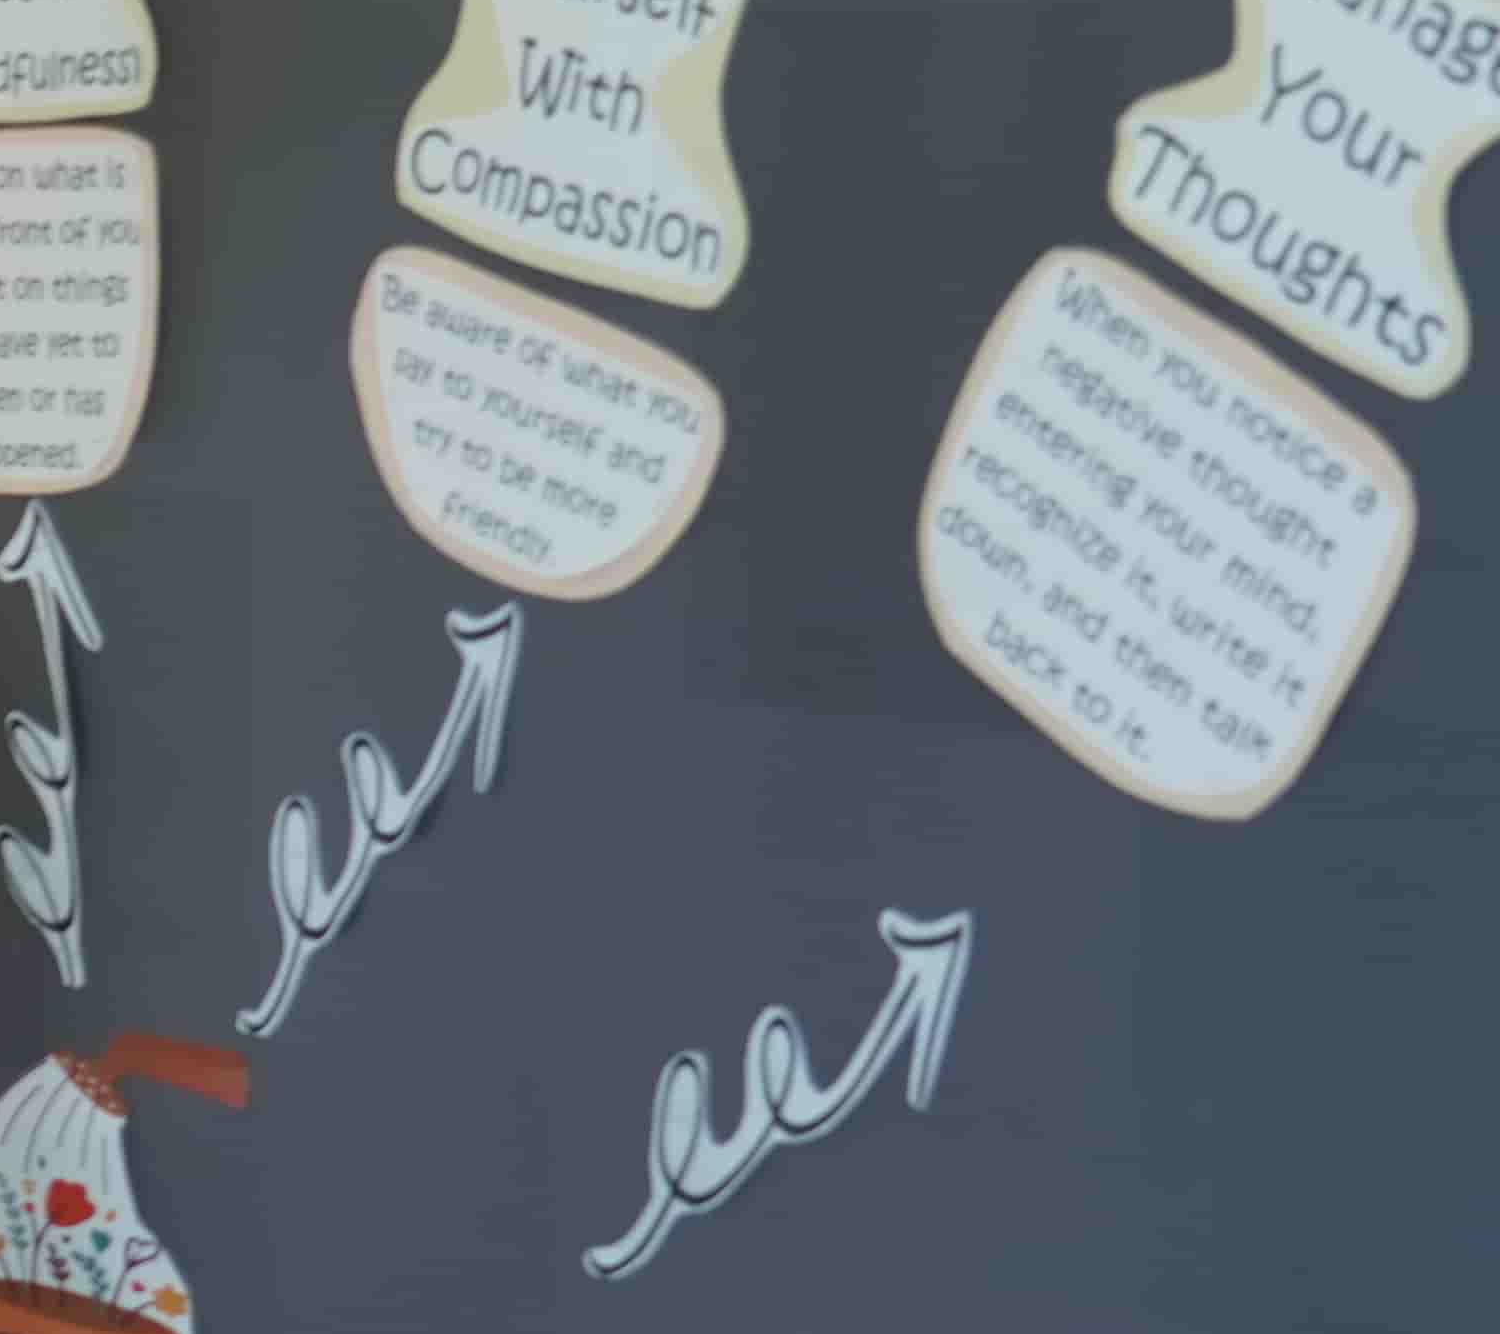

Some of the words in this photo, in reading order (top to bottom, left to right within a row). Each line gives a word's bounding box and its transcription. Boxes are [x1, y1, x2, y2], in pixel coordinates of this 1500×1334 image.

[518, 36, 645, 136] With
[1260, 42, 1422, 187] Your
[32, 157, 97, 191] what
[105, 155, 125, 191] is
[60, 215, 93, 248] of
[101, 219, 141, 249] you
[409, 127, 722, 275] Compassion
[12, 274, 44, 302] on
[51, 270, 131, 308] things
[1132, 123, 1447, 367] Thoughts
[28, 386, 57, 413] or
[62, 385, 106, 418] has
[46, 330, 85, 360] yet
[91, 330, 121, 359] to
[381, 272, 420, 316] Be
[425, 301, 513, 355] aware
[518, 335, 557, 375] of
[560, 354, 638, 409] what
[646, 390, 700, 437] you
[392, 345, 437, 387] say
[443, 368, 475, 402] to
[479, 384, 604, 459] yourself
[607, 440, 667, 486] and
[1056, 267, 1151, 358] When
[1153, 349, 1223, 410] you
[1227, 395, 1348, 492] notice
[1350, 484, 1380, 518] a
[412, 418, 454, 458] try
[461, 438, 494, 473] to
[498, 454, 538, 492] be
[540, 475, 618, 530] more
[995, 389, 1138, 511] entering
[1140, 493, 1218, 563] your
[1038, 342, 1184, 459] negative
[1189, 448, 1338, 569] thought
[960, 444, 1124, 573] recognize
[1167, 595, 1273, 681] write
[1273, 663, 1307, 711] it
[983, 607, 1068, 691] back
[1072, 683, 1113, 725] to
[1041, 581, 1110, 645] and
[1114, 632, 1195, 708] then
[1200, 697, 1275, 763] talk
